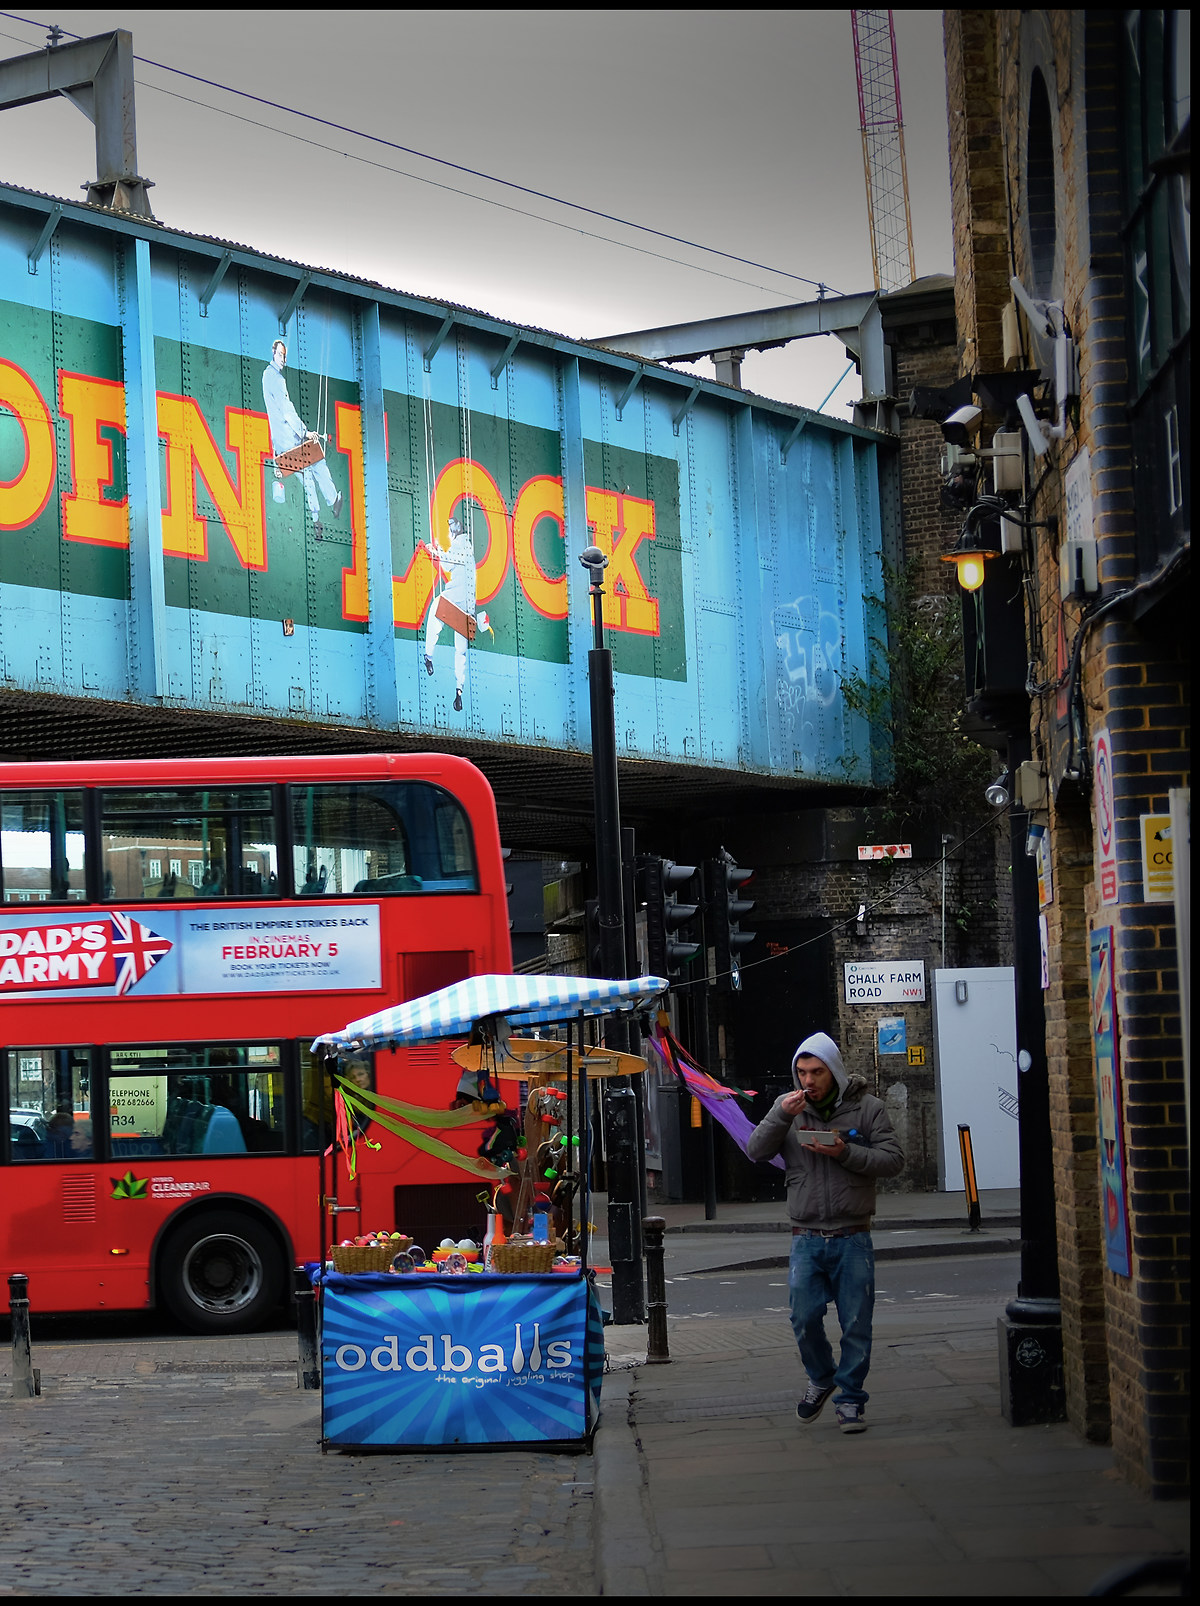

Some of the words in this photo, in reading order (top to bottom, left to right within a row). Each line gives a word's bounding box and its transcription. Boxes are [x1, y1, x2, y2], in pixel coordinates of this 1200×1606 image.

[335, 401, 660, 636] LOCK
[190, 923, 210, 931] THE
[212, 921, 253, 931] BRITISH
[255, 920, 293, 930] EMPIRE
[296, 919, 338, 928] STRIKES
[340, 918, 369, 927] BACK
[249, 936, 260, 944] IN
[263, 934, 311, 944] CINEMAS
[222, 943, 322, 960] FEBRUARY
[328, 943, 339, 957] 5
[848, 974, 885, 985] CHALK
[890, 973, 922, 983] FARM
[849, 987, 882, 998] ROAD
[902, 988, 923, 996] NW1
[910, 1048, 922, 1063] H
[126, 1098, 154, 1106] 682666
[335, 1322, 572, 1374] oddballs
[435, 1374, 457, 1384] the
[461, 1374, 502, 1389] original
[506, 1371, 545, 1387] juggling
[550, 1370, 575, 1382] shop
